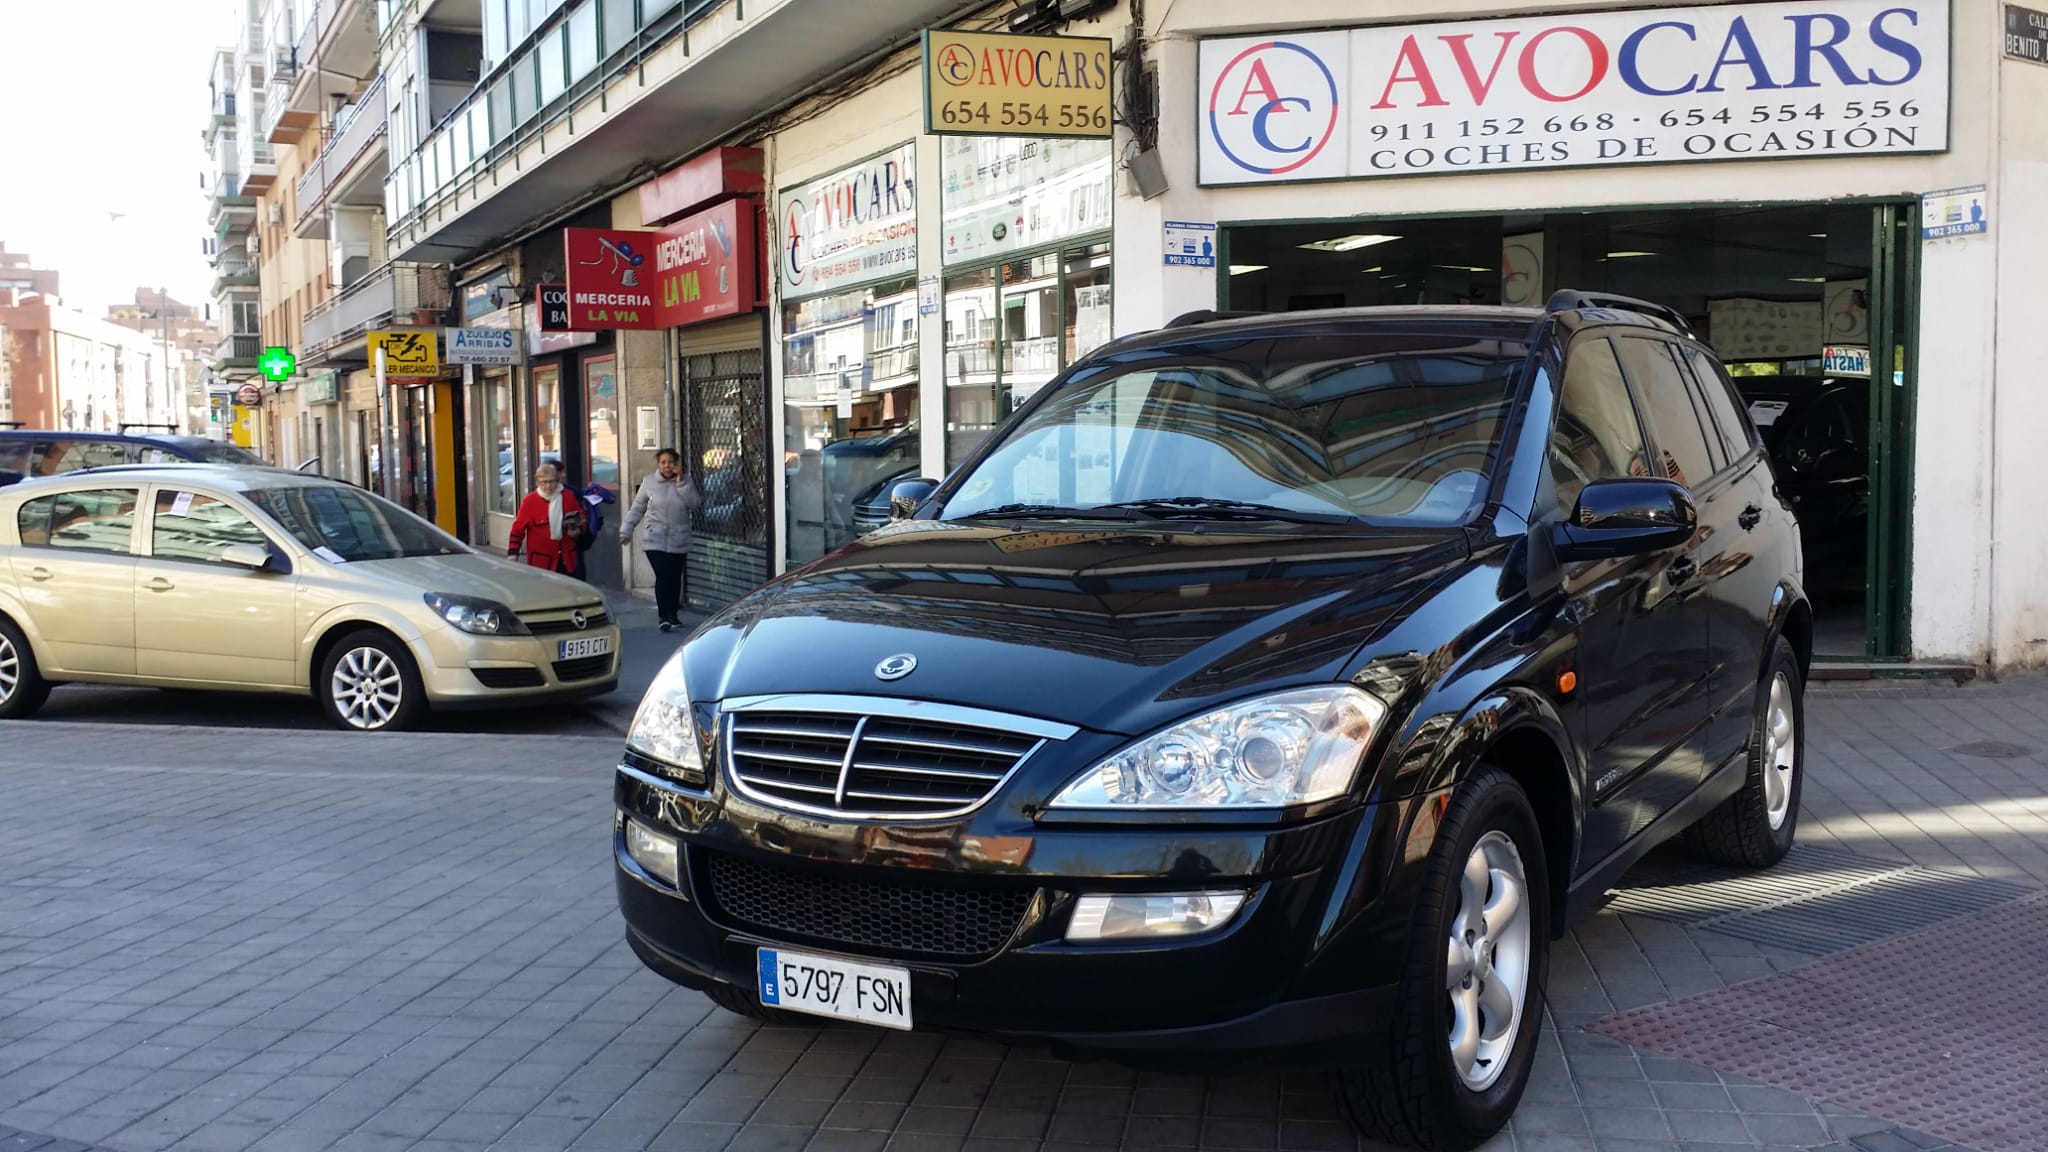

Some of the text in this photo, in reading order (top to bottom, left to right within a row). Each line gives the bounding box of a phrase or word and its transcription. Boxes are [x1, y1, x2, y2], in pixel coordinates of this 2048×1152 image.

[2029, 13, 2048, 29] CAL
[1370, 7, 1922, 110] AVOCARS
[2006, 33, 2040, 58] BENITO
[978, 47, 1107, 90] AVOCARS
[942, 100, 1107, 129] 654 554 556
[1370, 121, 1436, 142] 911
[1460, 117, 1525, 138] 152
[1544, 113, 1614, 134] 668
[1659, 107, 1733, 128] 654
[1750, 103, 1826, 123] 554
[1843, 99, 1920, 119] 556
[1370, 122, 1920, 169] COCHES DE OCASIÓN
[1928, 223, 1980, 237] 902 365 000
[657, 228, 707, 273] MERCERIA
[1169, 256, 1182, 265] 902
[1183, 256, 1196, 265] 365
[576, 293, 651, 306] MERCERIA
[664, 271, 701, 308] LA VIA
[551, 310, 568, 323] BA
[588, 310, 639, 322] LA VIA
[567, 638, 609, 656] 9151 CTV
[765, 963, 904, 1016] E 5797 FSN
